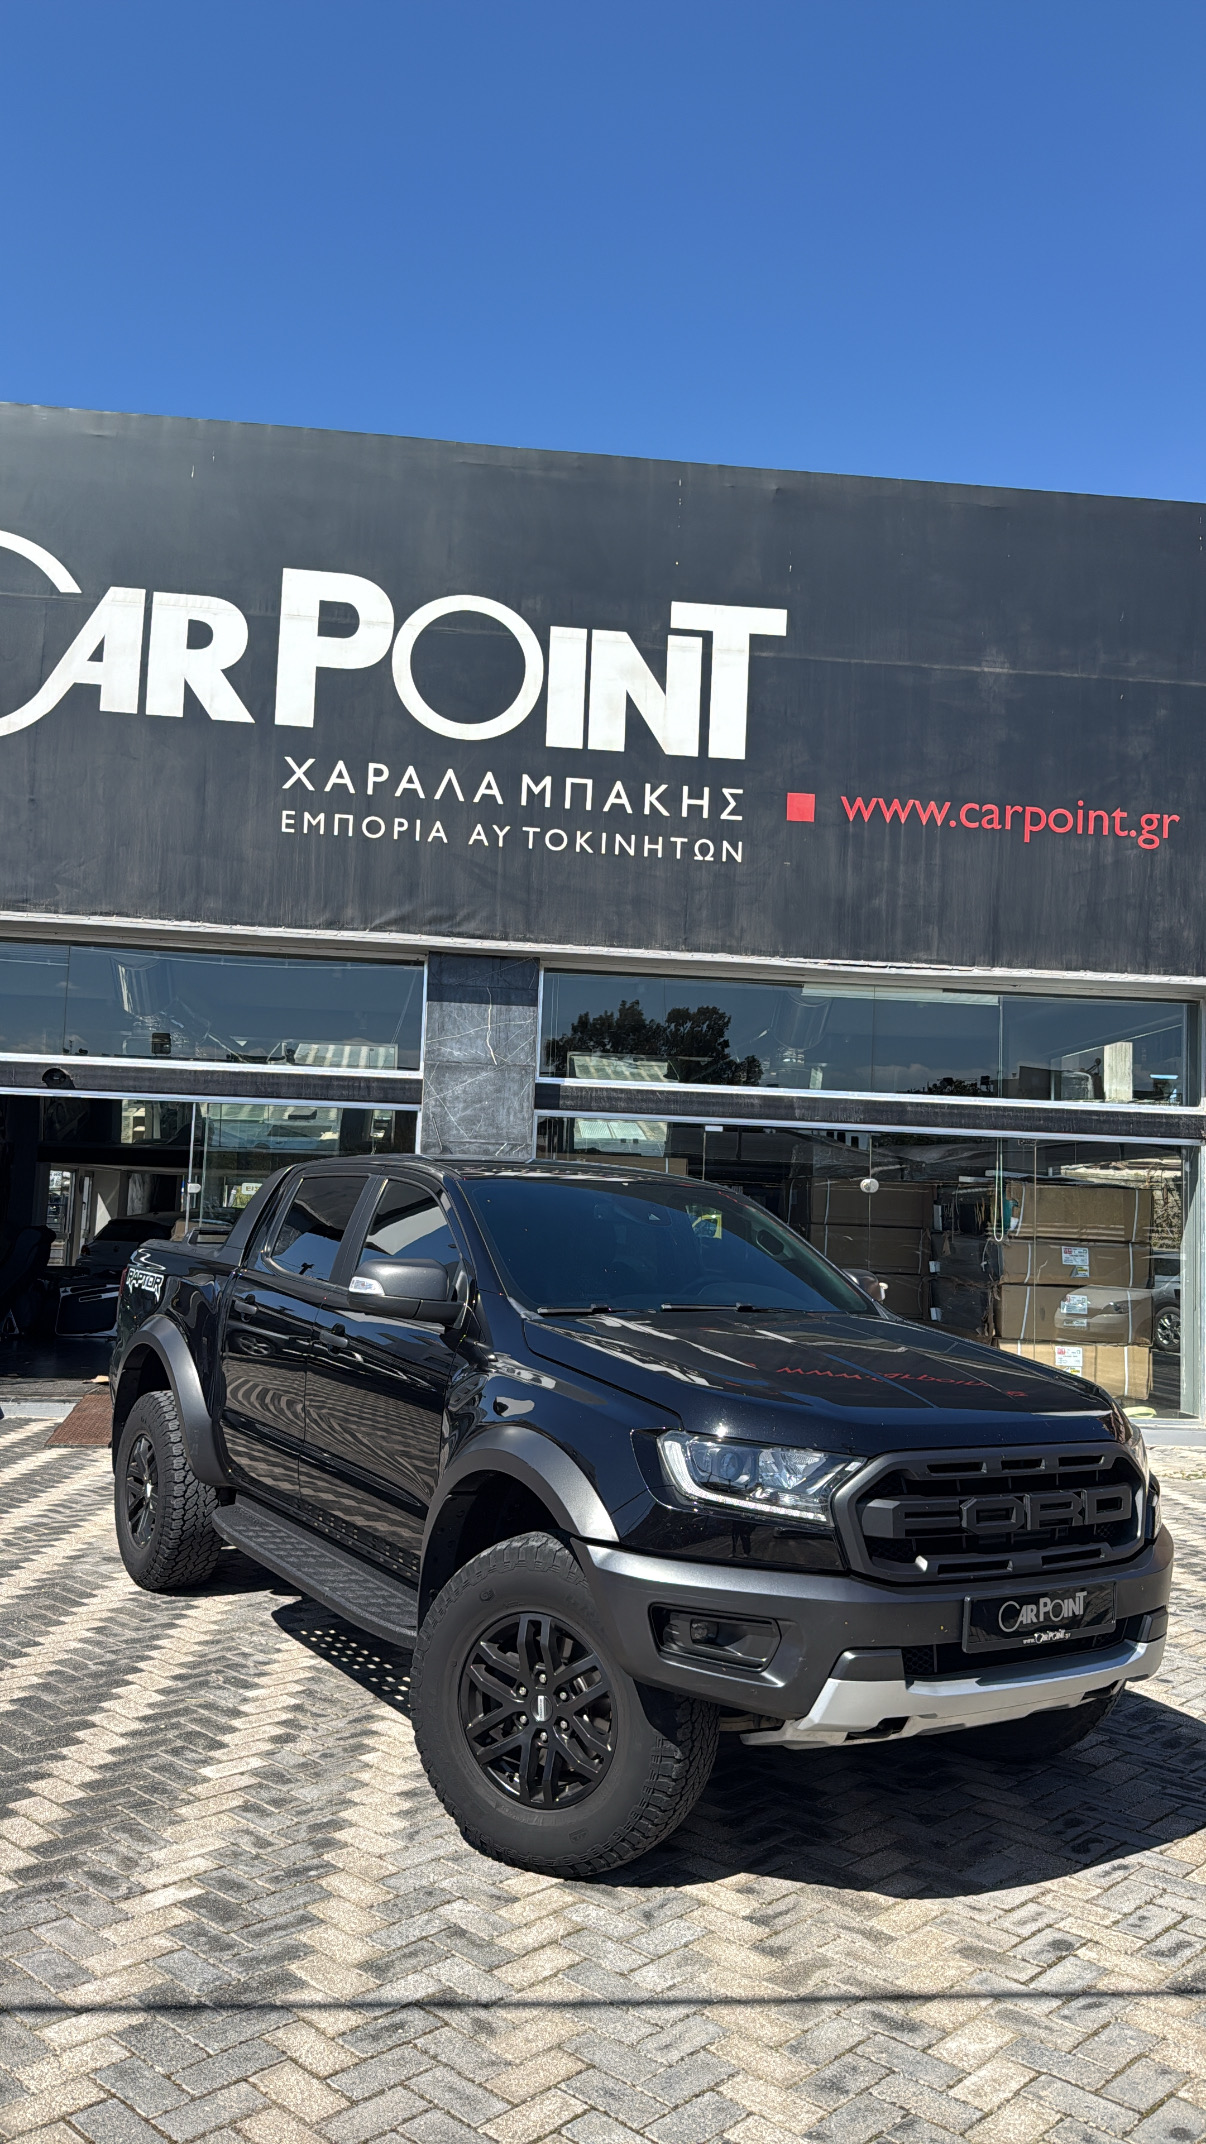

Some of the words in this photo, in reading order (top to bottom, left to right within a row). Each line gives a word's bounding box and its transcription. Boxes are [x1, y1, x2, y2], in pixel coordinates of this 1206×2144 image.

[281, 811, 448, 844] ΕΜΠΟΡΙΑ
[841, 797, 1180, 850] www.carpoint.gr
[126, 1268, 165, 1302] RAPTOR
[862, 1485, 1132, 1538] FORD
